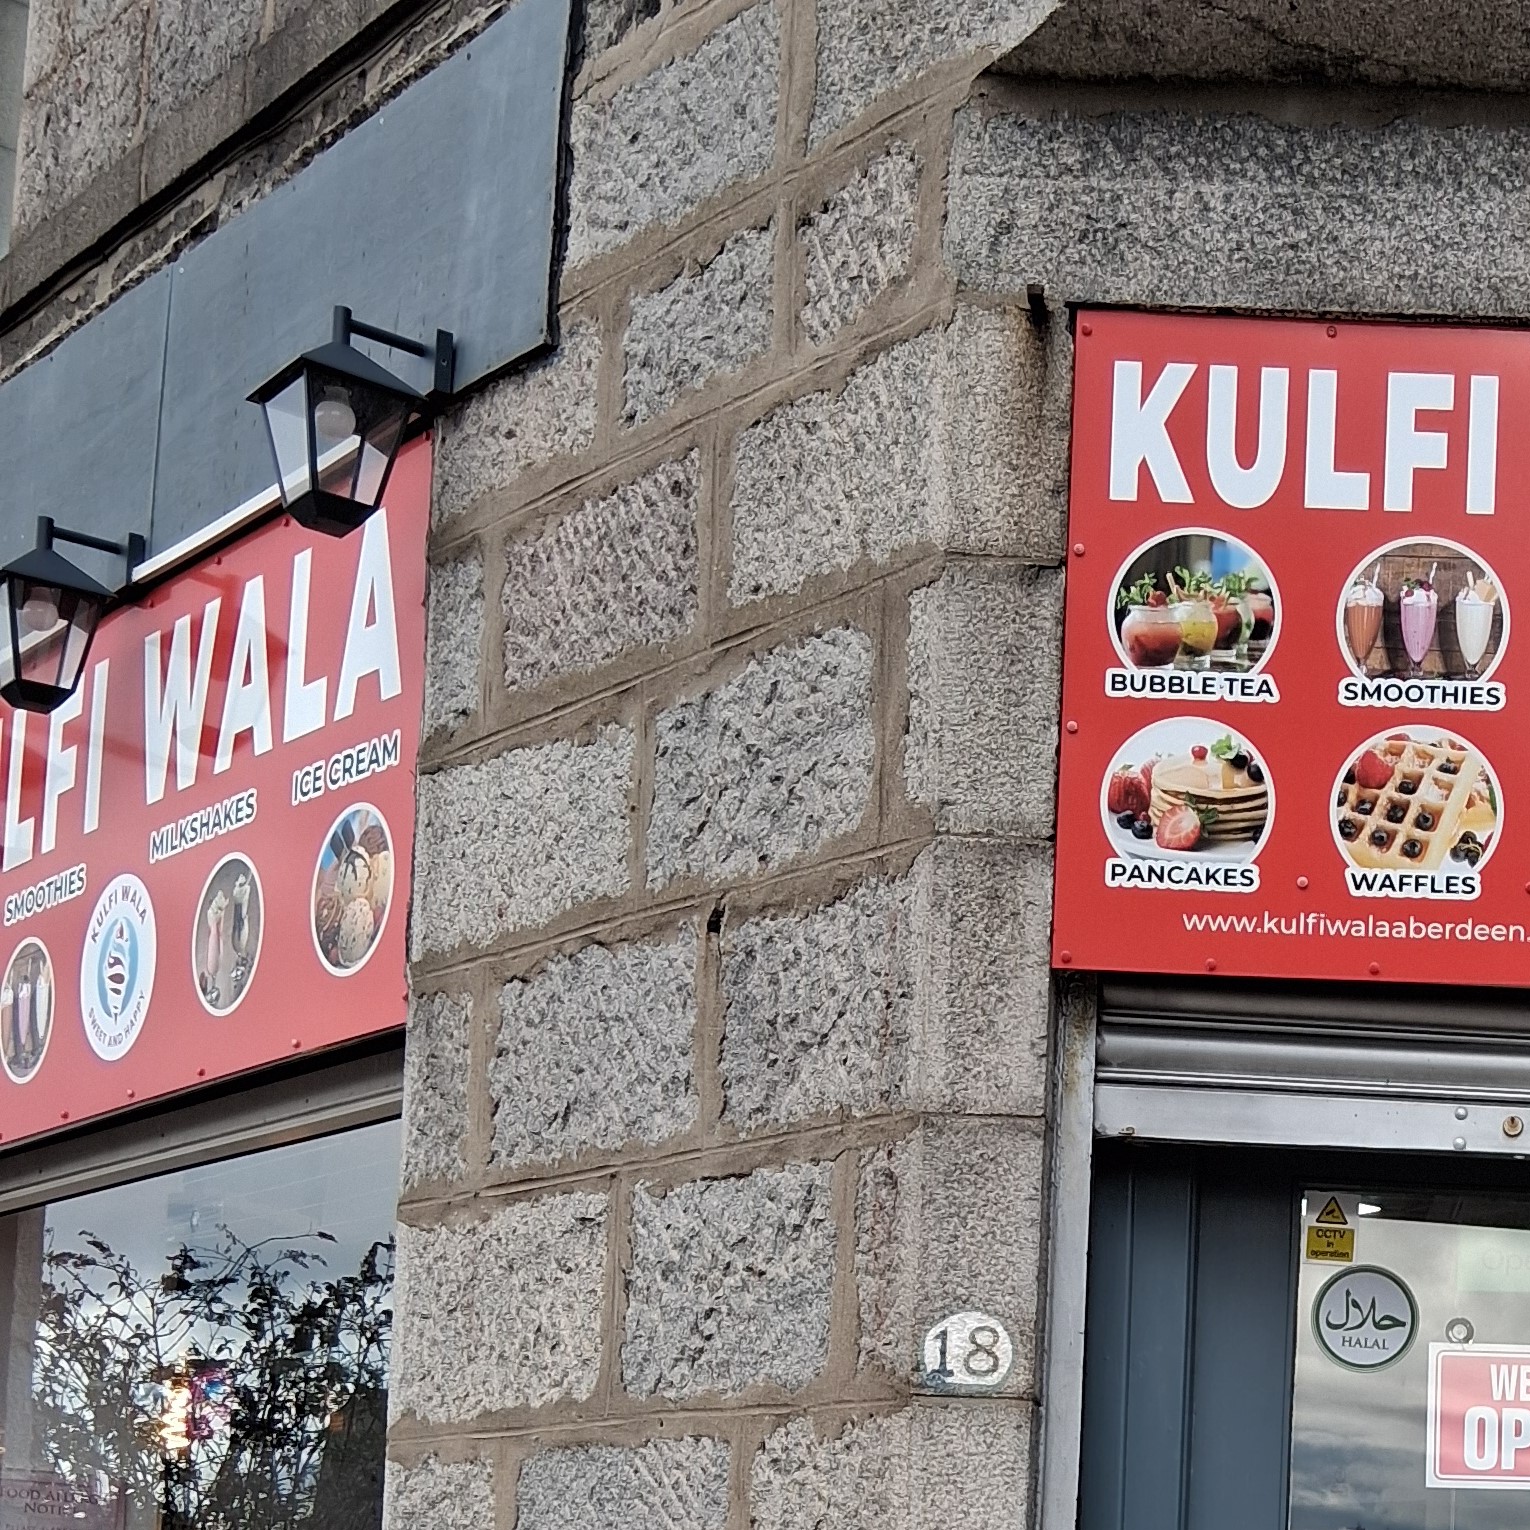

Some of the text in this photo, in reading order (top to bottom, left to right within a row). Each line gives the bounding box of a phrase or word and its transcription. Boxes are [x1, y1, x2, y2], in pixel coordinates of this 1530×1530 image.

[1109, 361, 1500, 515] KULFI
[0, 508, 402, 873] LFI WALA
[1110, 673, 1274, 698] BUBBLE TEA
[1343, 682, 1502, 706] SMOOTHIES
[293, 735, 399, 801] ICE CREAM
[151, 793, 256, 858] MILKSHAKES
[5, 867, 85, 922] SMOOTHIES
[1110, 863, 1255, 887] PANCAKES
[1350, 872, 1476, 895] WAFFLES
[91, 885, 147, 943] KULFI WALA
[1316, 1228, 1346, 1239] CCTV
[1325, 1288, 1408, 1331] حلال
[926, 1325, 1001, 1378] 18
[1341, 1335, 1390, 1351] HALAL
